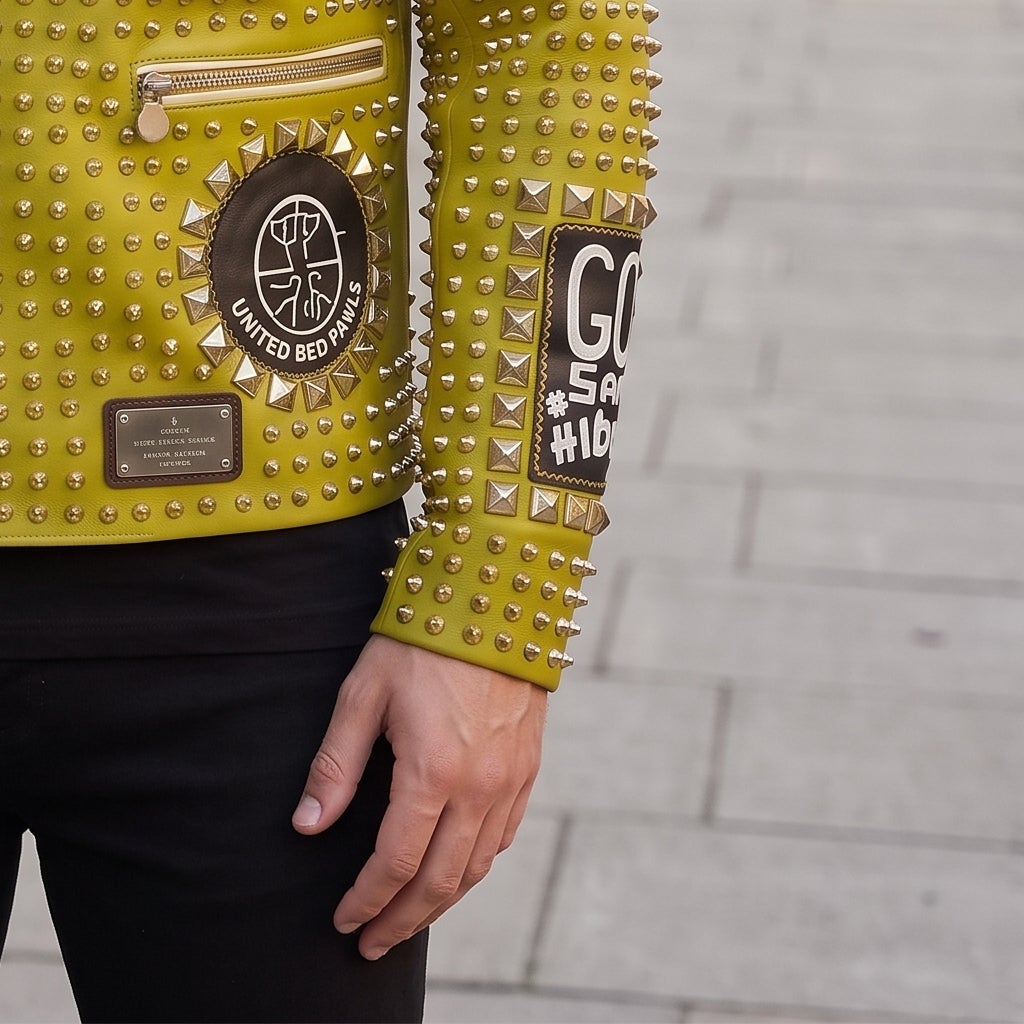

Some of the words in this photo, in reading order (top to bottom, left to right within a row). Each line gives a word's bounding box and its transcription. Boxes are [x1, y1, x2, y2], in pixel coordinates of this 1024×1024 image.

[231, 297, 291, 360] UNITED
[295, 338, 328, 362] BED
[327, 280, 362, 347] PAWLS
